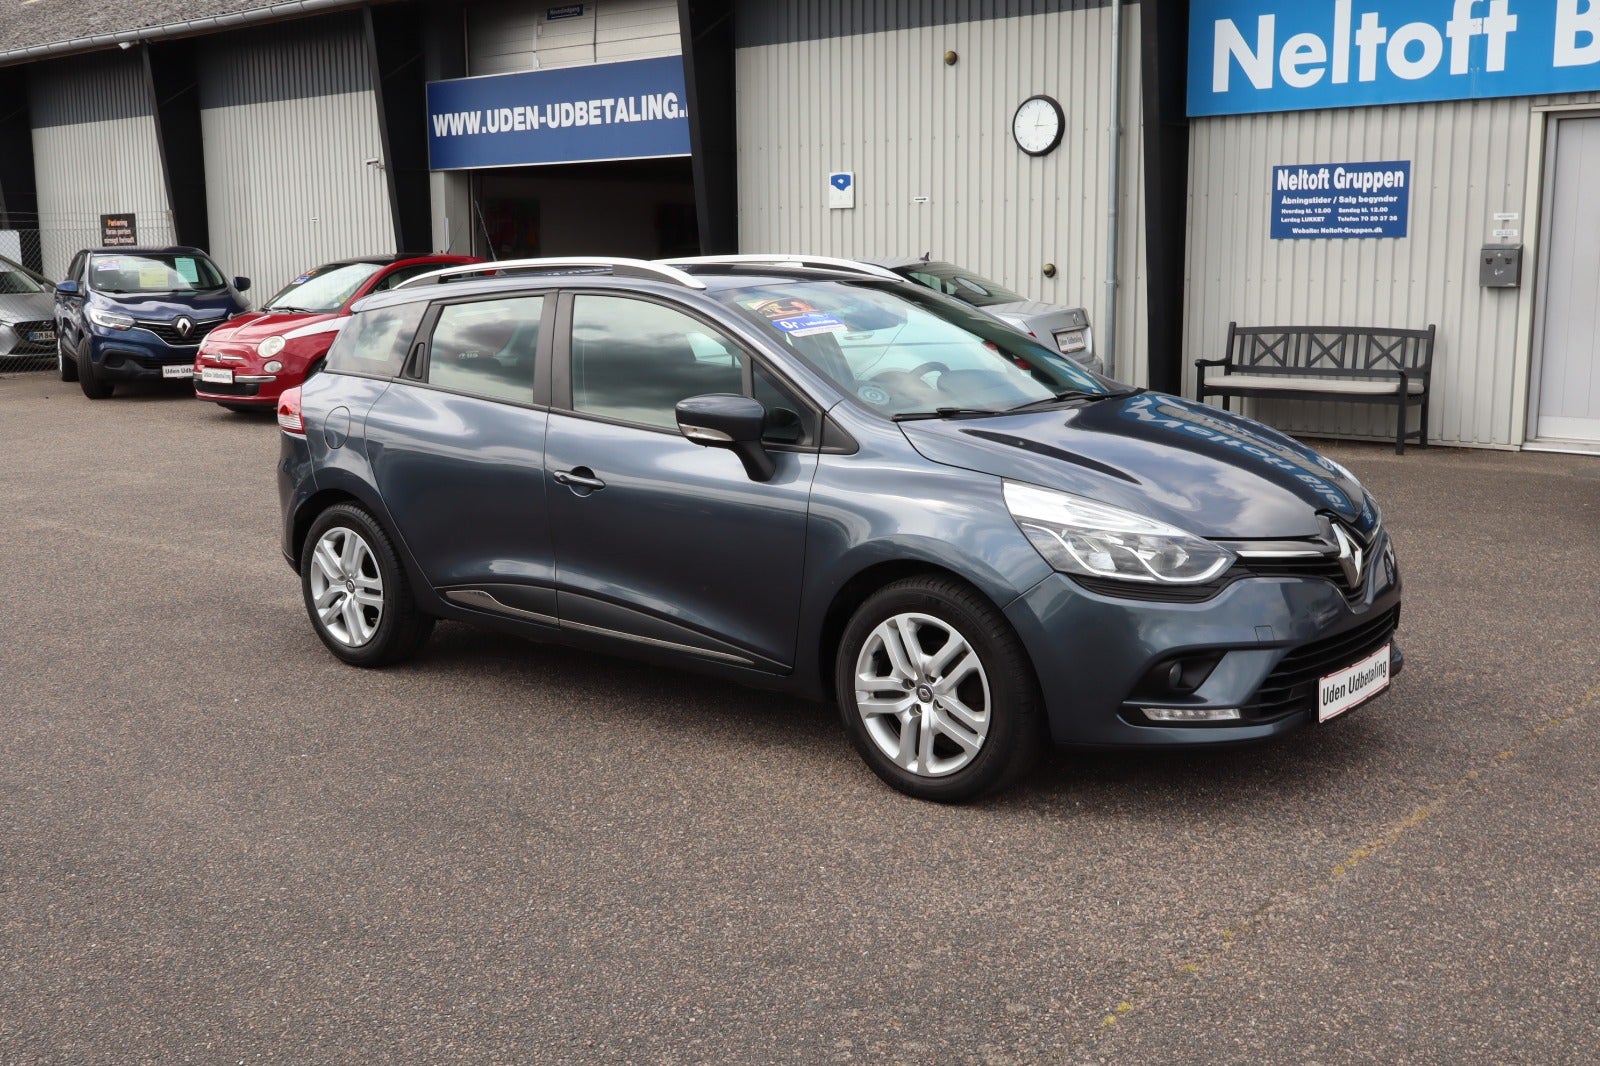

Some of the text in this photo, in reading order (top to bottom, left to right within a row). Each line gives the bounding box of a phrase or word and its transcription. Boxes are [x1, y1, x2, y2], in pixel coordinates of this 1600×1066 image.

[1212, 0, 1518, 94] Neltoft
[432, 91, 689, 138] WWW.UDEN-UDBETALING.
[1277, 167, 1405, 193] Neltoft Gruppen
[1281, 195, 1332, 205] Åbningstider
[1338, 196, 1357, 204] Salg
[1358, 195, 1398, 204] begynder
[1322, 660, 1387, 706] Uden Udbetaling
